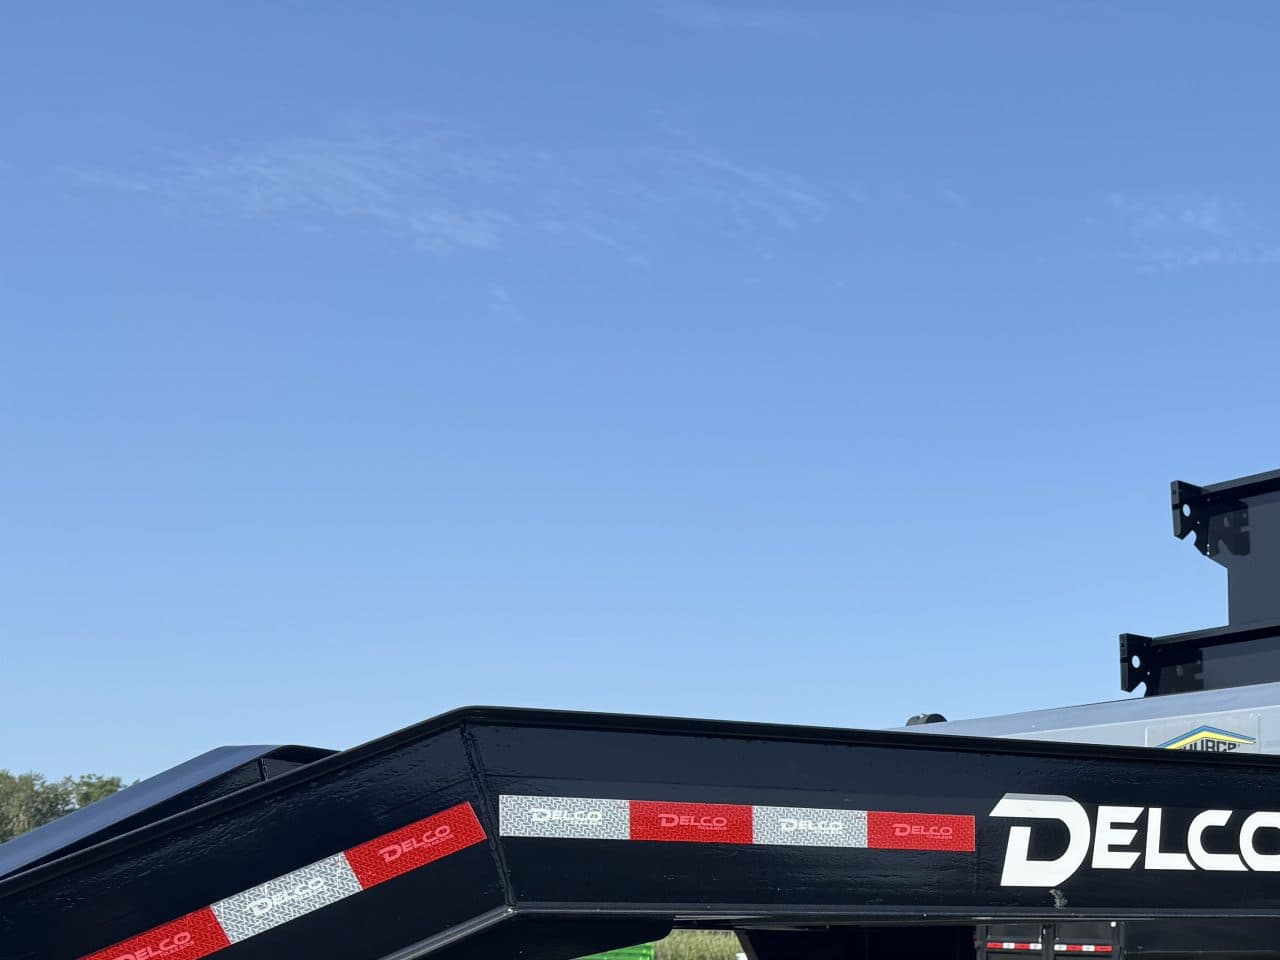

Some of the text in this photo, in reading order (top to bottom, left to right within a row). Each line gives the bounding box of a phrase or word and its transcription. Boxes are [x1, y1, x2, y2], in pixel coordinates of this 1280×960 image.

[531, 808, 602, 823] DELCO
[658, 813, 728, 827] DELCO
[779, 818, 842, 832] DELCO
[893, 823, 953, 836] DELCO
[378, 825, 451, 863] DELCO
[248, 877, 324, 916] DELCO
